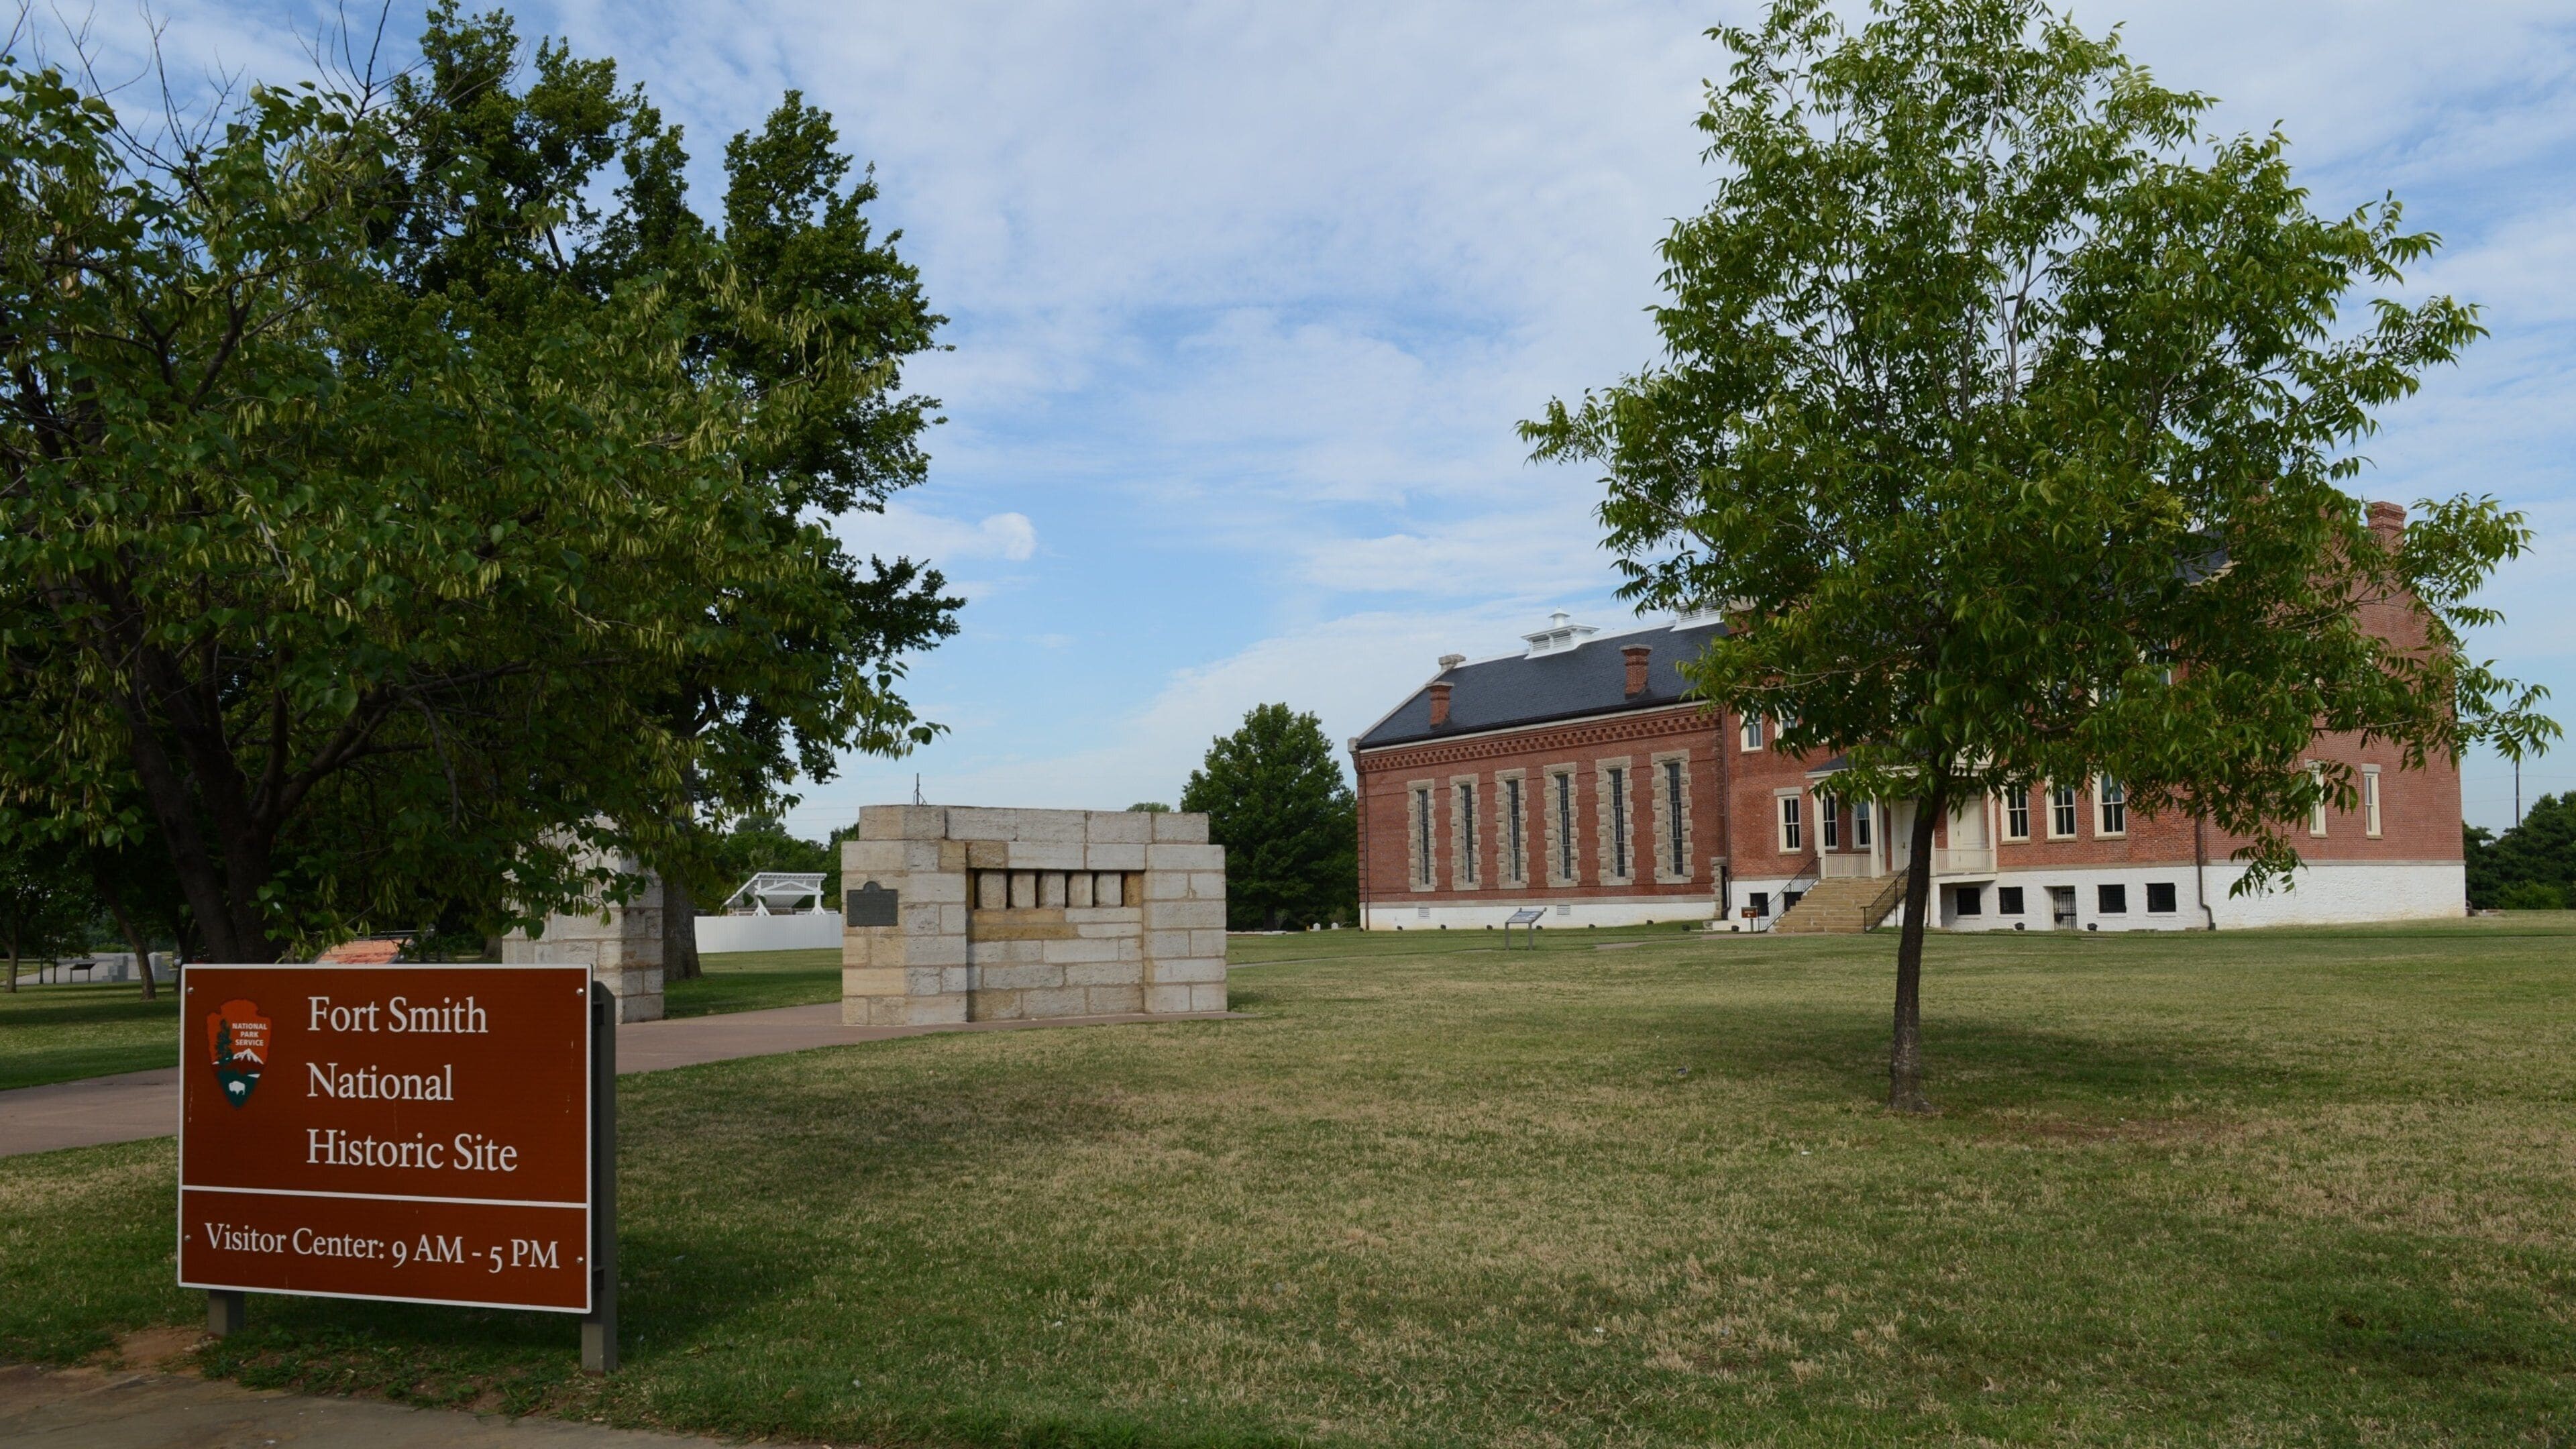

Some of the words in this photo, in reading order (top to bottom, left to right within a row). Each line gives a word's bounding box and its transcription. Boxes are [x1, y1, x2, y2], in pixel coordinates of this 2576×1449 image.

[308, 997, 379, 1032] Fort
[389, 996, 488, 1033] Smith
[307, 1063, 453, 1100] National
[307, 1129, 443, 1169] Historic
[454, 1134, 517, 1171] Site
[205, 1223, 286, 1252] Visitor
[293, 1228, 384, 1258] Center:
[392, 1241, 407, 1267] 9
[413, 1234, 464, 1263] AM
[489, 1246, 502, 1273] 5
[511, 1240, 559, 1269] PM
